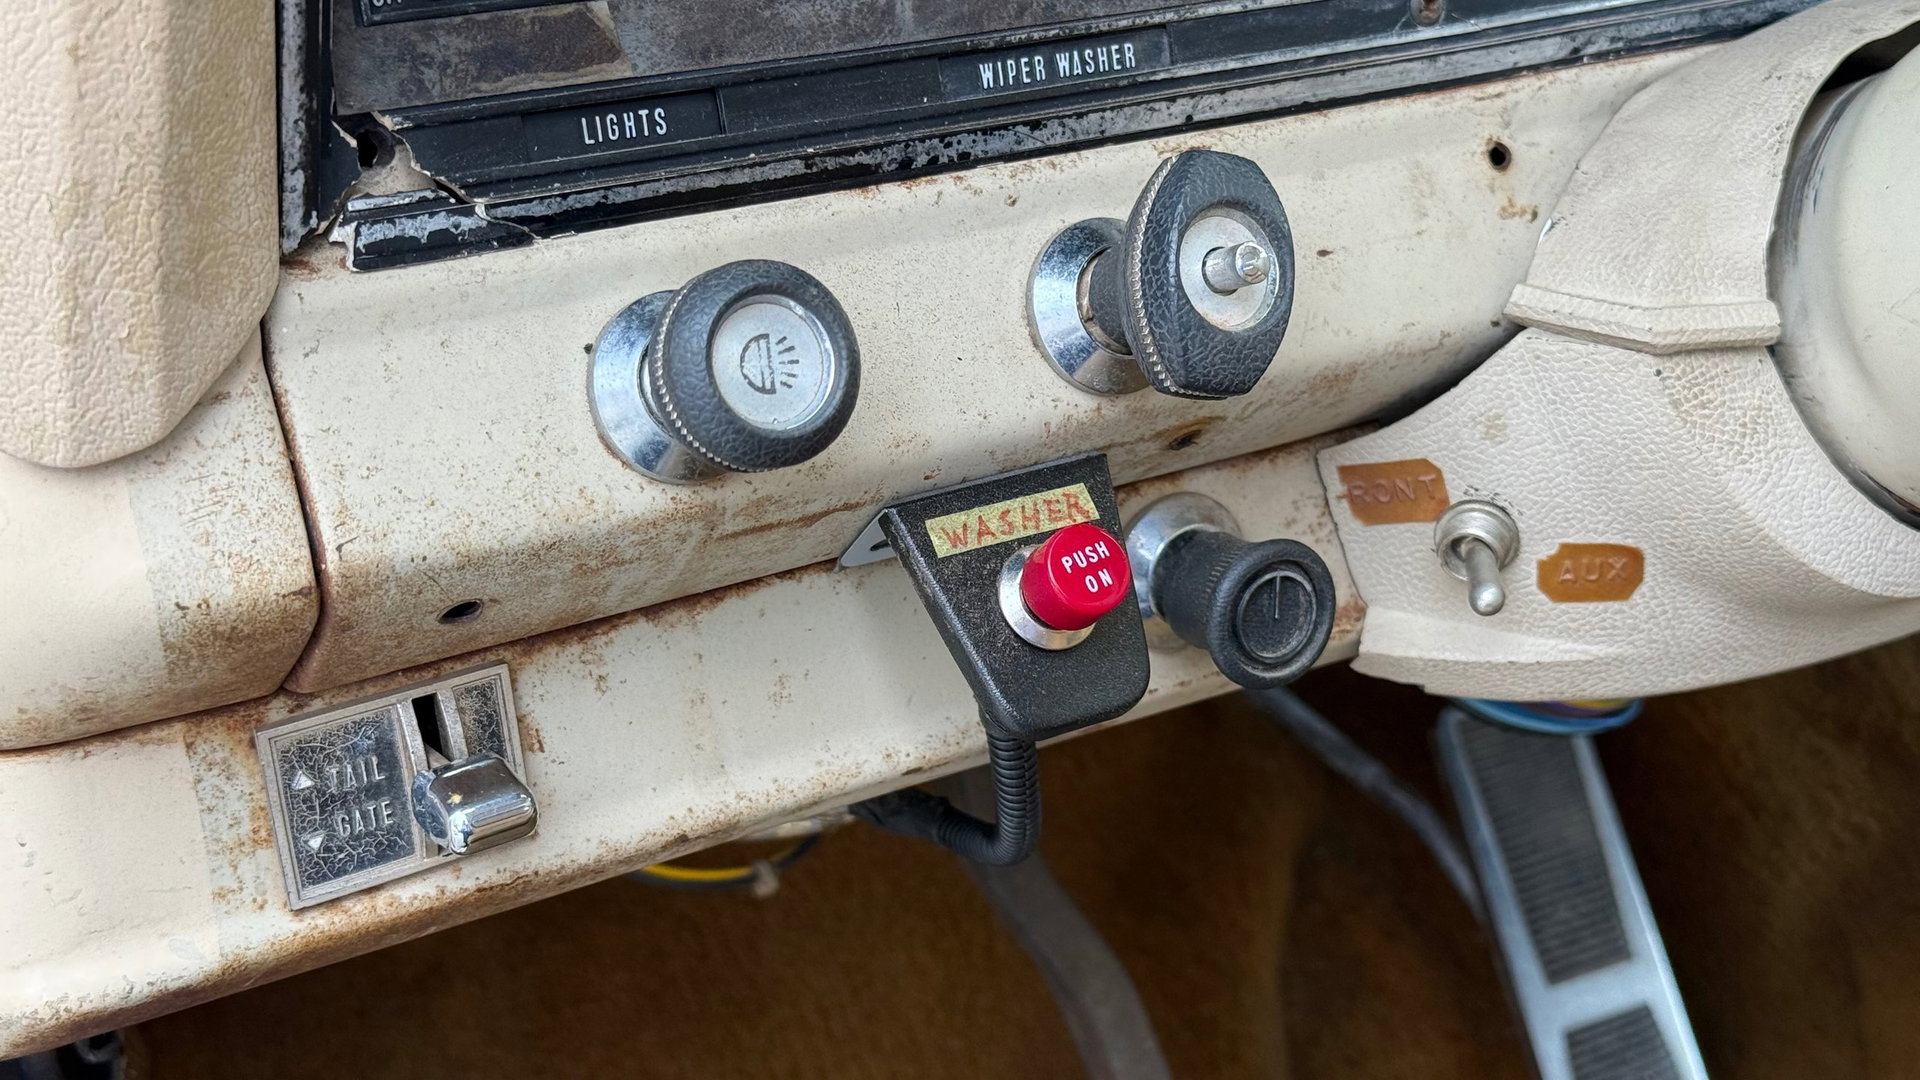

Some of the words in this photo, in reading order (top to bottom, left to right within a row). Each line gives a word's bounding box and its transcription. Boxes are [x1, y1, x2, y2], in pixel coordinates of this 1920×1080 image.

[979, 55, 1046, 90] WIPER
[1055, 43, 1136, 78] WASHER
[581, 107, 668, 145] LIGHTS
[940, 491, 1091, 549] WASHER
[1060, 540, 1110, 574] PUSH
[1558, 556, 1628, 584] AUX
[1084, 568, 1113, 593] ON
[326, 757, 386, 793] TAIL
[336, 799, 394, 838] GATE
